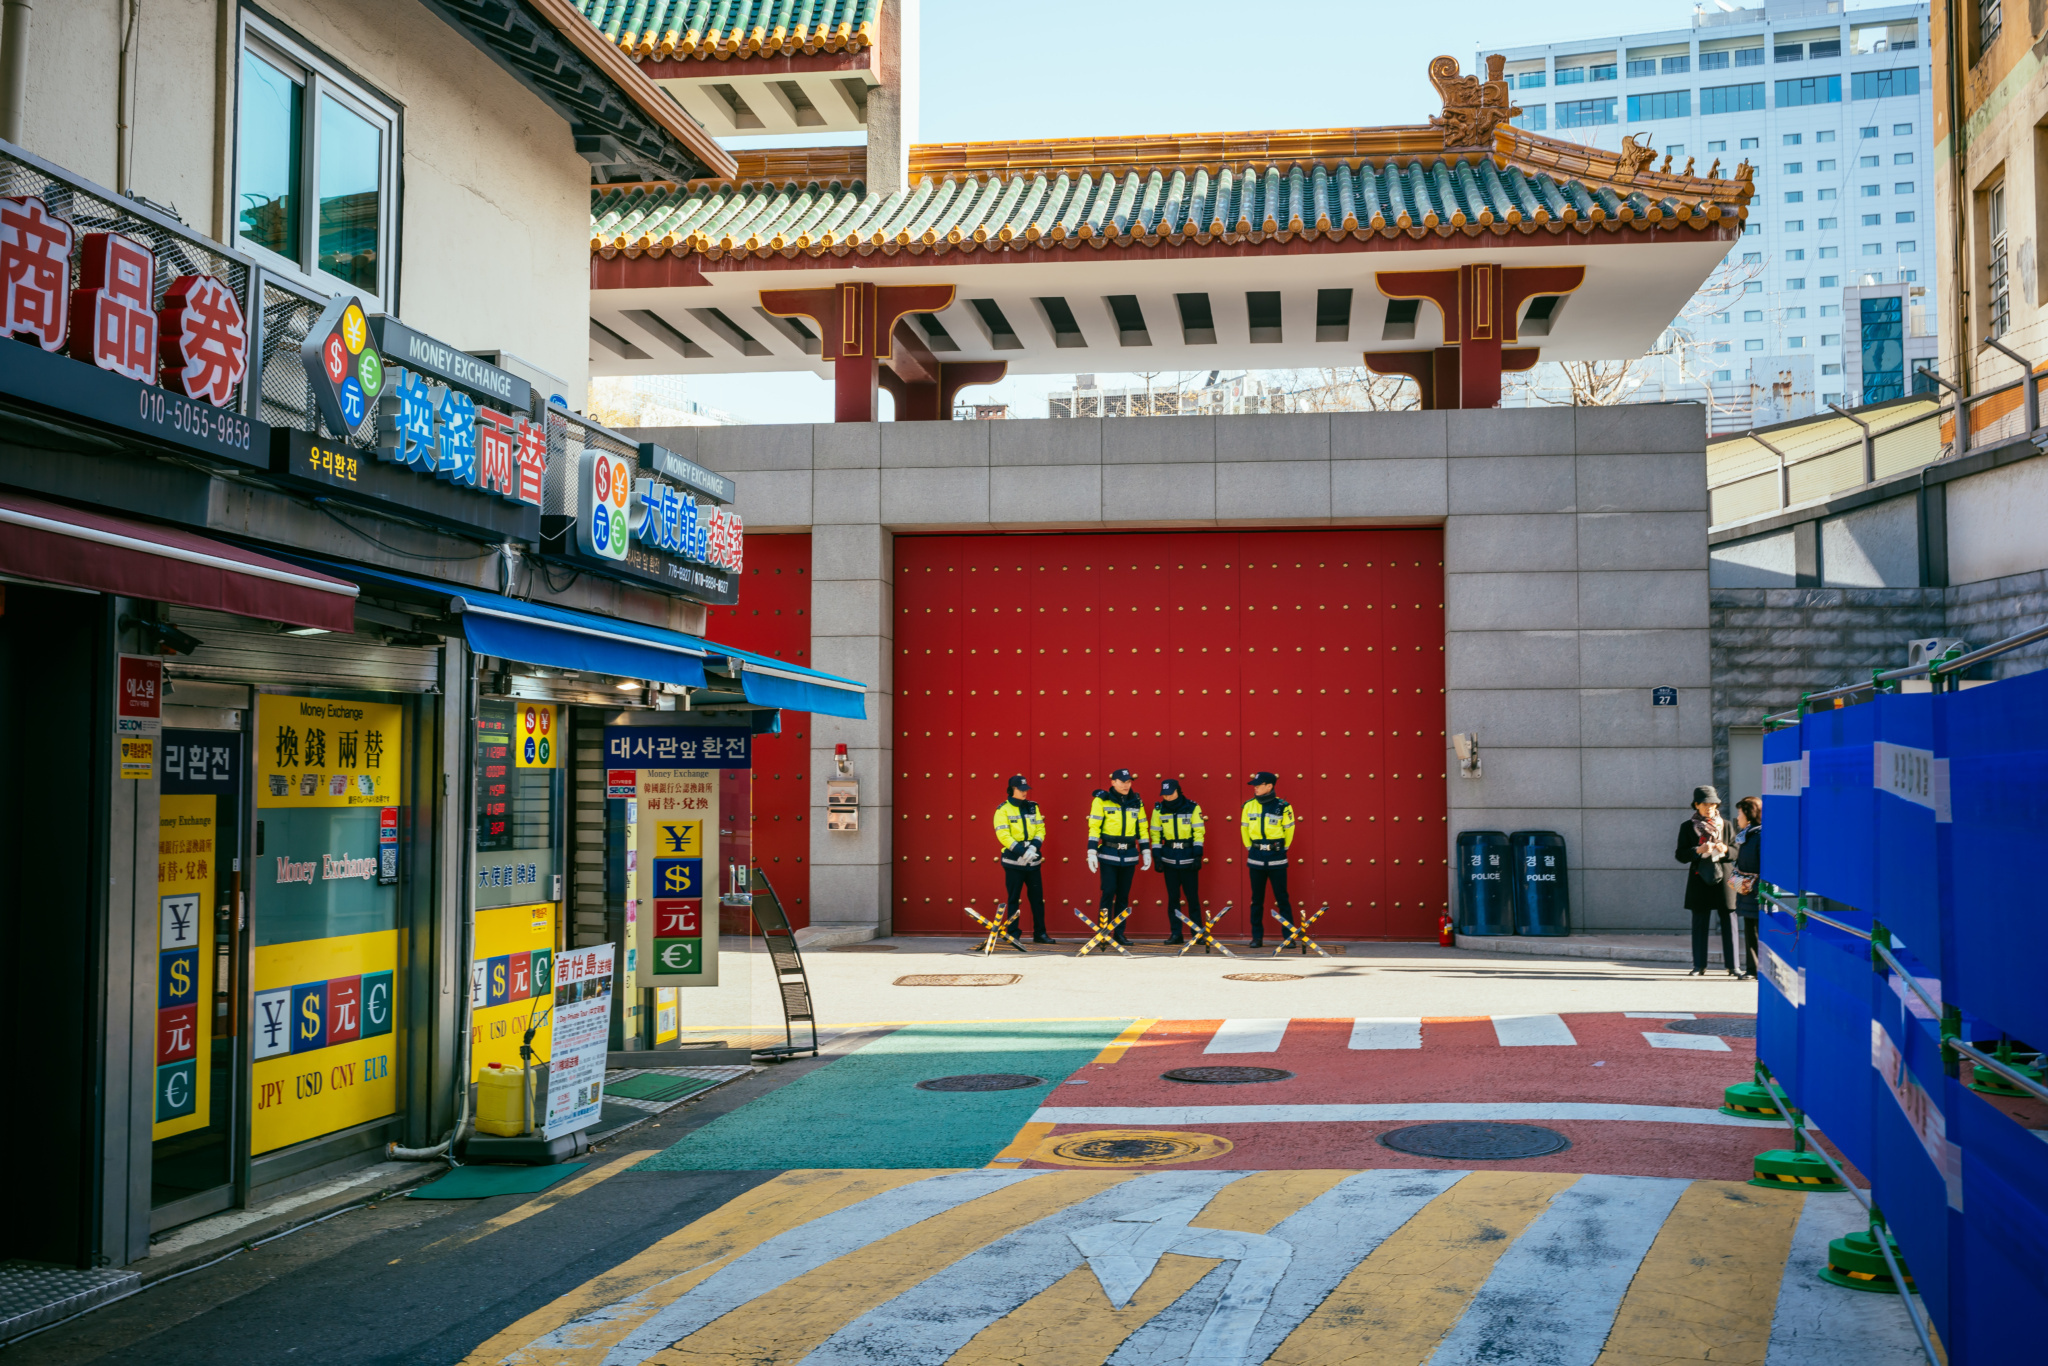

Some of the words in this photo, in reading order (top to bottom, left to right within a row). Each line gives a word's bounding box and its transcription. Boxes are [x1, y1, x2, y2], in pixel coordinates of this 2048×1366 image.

[0, 203, 244, 403] 商品券
[409, 336, 452, 372] MONEY
[455, 358, 512, 398] EXCHANGE
[344, 384, 361, 419] 元
[140, 389, 250, 450] 010-5055-9858
[309, 446, 357, 482] 우리환전
[667, 455, 691, 479] MONEY
[691, 466, 723, 495] EXCHANGE
[596, 512, 607, 543] 元
[126, 678, 155, 699] 에스원
[1658, 695, 1671, 705] 27
[119, 719, 142, 731] SECOM
[300, 702, 326, 719] Money
[327, 704, 363, 721] Exchange
[165, 745, 230, 780] 리환전
[525, 743, 535, 758] 元
[701, 737, 746, 759] 환전
[609, 786, 636, 794] SECOM
[647, 769, 672, 779] Money
[673, 769, 709, 779] Exchange
[159, 816, 177, 828] oney
[179, 816, 211, 827] Exchange
[276, 855, 317, 885] Money
[322, 852, 377, 880] Exchange
[661, 905, 696, 932] 元
[513, 961, 528, 993] 元
[333, 988, 356, 1033] 元
[165, 1014, 191, 1055] 元
[472, 1025, 483, 1044] PY
[490, 1020, 507, 1039] USD
[512, 1015, 528, 1034] CNY
[532, 1010, 549, 1028] EUR
[258, 1080, 285, 1110] JPY
[296, 1071, 322, 1099] USD
[331, 1062, 356, 1090] CNY
[364, 1055, 388, 1082] EUR
